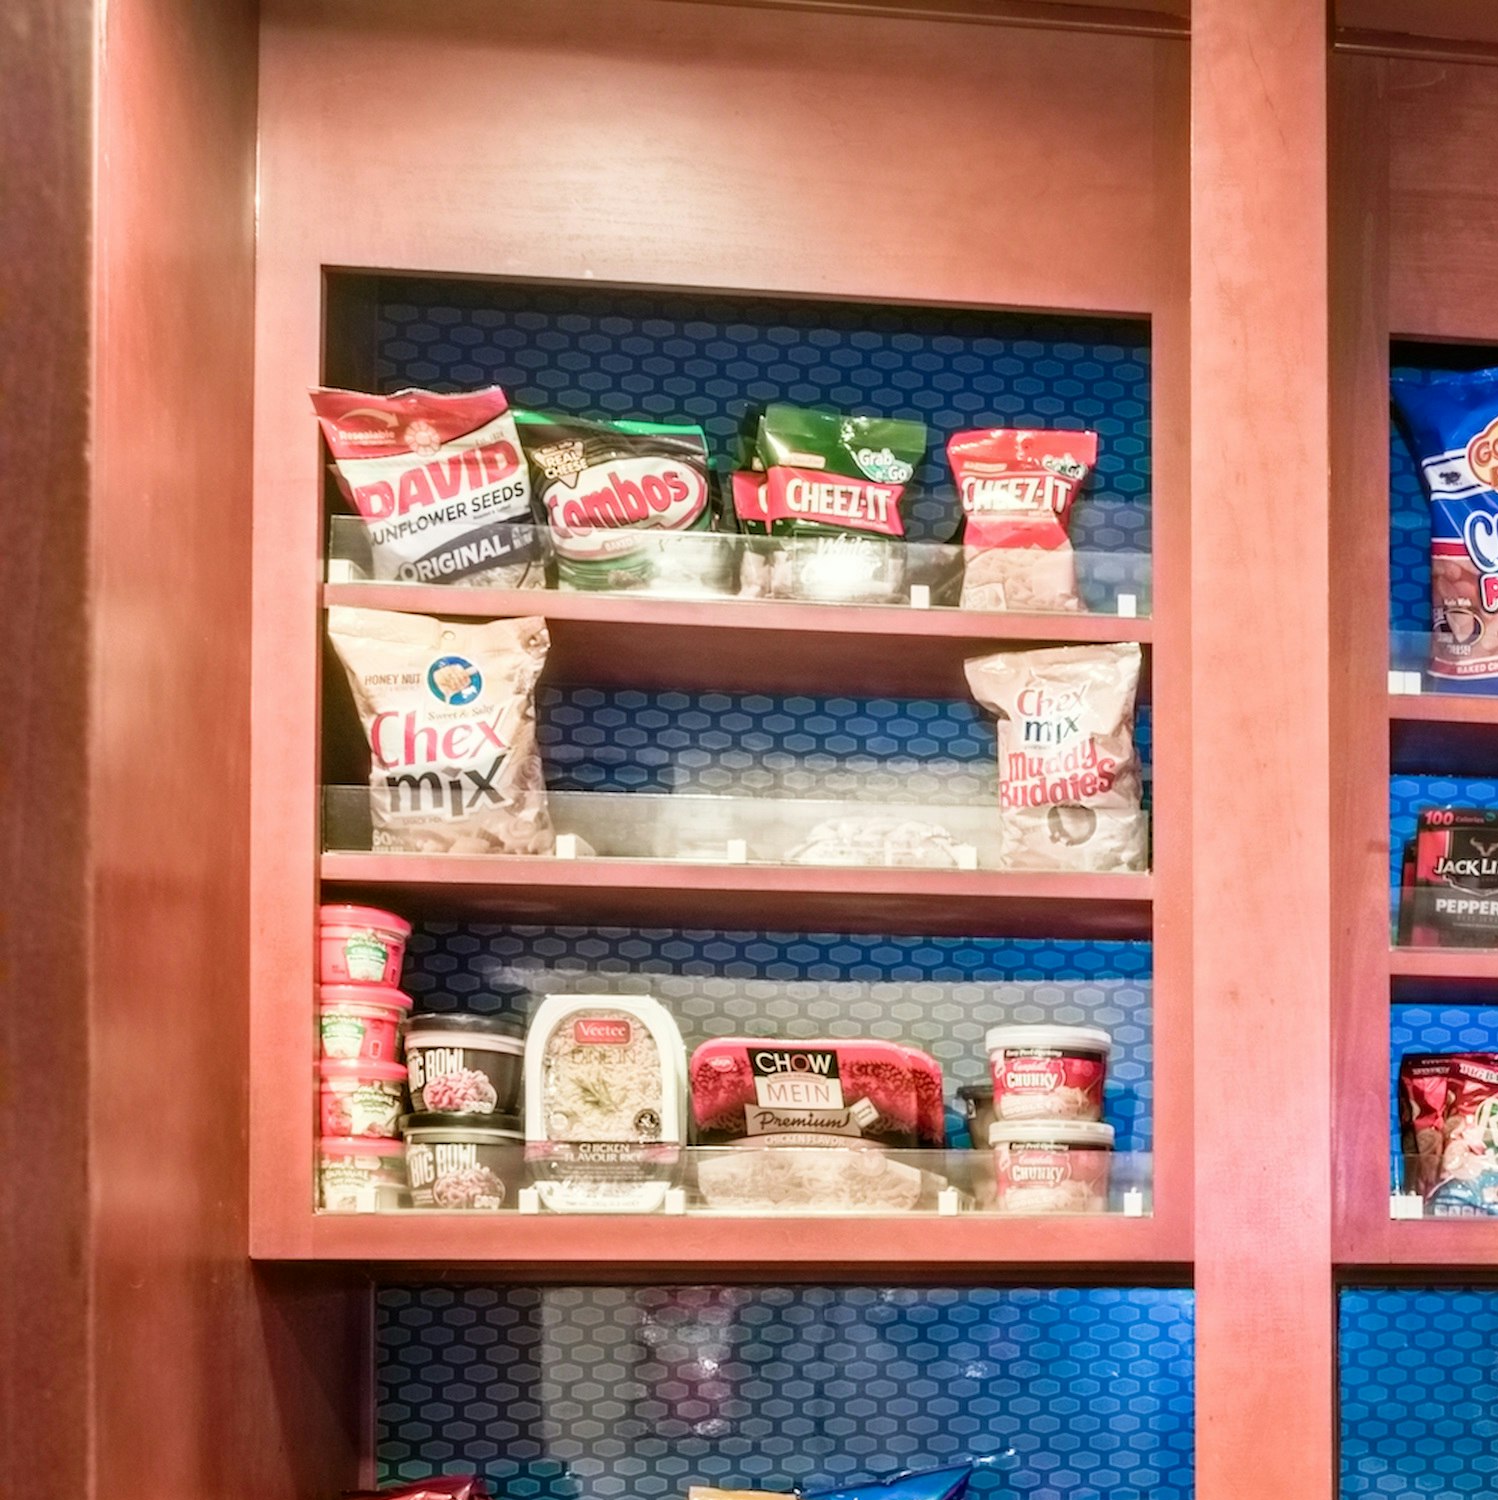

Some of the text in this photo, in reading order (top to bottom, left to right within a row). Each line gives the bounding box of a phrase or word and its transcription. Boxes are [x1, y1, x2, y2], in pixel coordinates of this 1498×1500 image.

[354, 438, 521, 523] DAVID
[471, 481, 525, 518] SEEDS
[548, 470, 691, 540] Combos
[785, 477, 892, 523] CHEEZ-IT
[399, 533, 512, 584] ORIGINAL
[364, 673, 422, 687] HONEY NUT
[1016, 683, 1088, 718] Chex
[370, 706, 508, 771] Chex
[1023, 713, 1081, 745] mix
[1008, 735, 1099, 784] Muddy
[386, 752, 510, 818] mix
[999, 757, 1118, 809] Buddies
[1424, 810, 1454, 826] 100
[1433, 856, 1481, 877] JACK
[754, 1051, 833, 1075] CHOW
[1006, 1071, 1058, 1089] CHUNKY
[766, 1083, 831, 1104] MEIN
[752, 1111, 852, 1131] Premium
[763, 1134, 805, 1146] CHICKEN
[410, 1150, 435, 1189] BIG
[1011, 1165, 1065, 1183] CHUNKY
